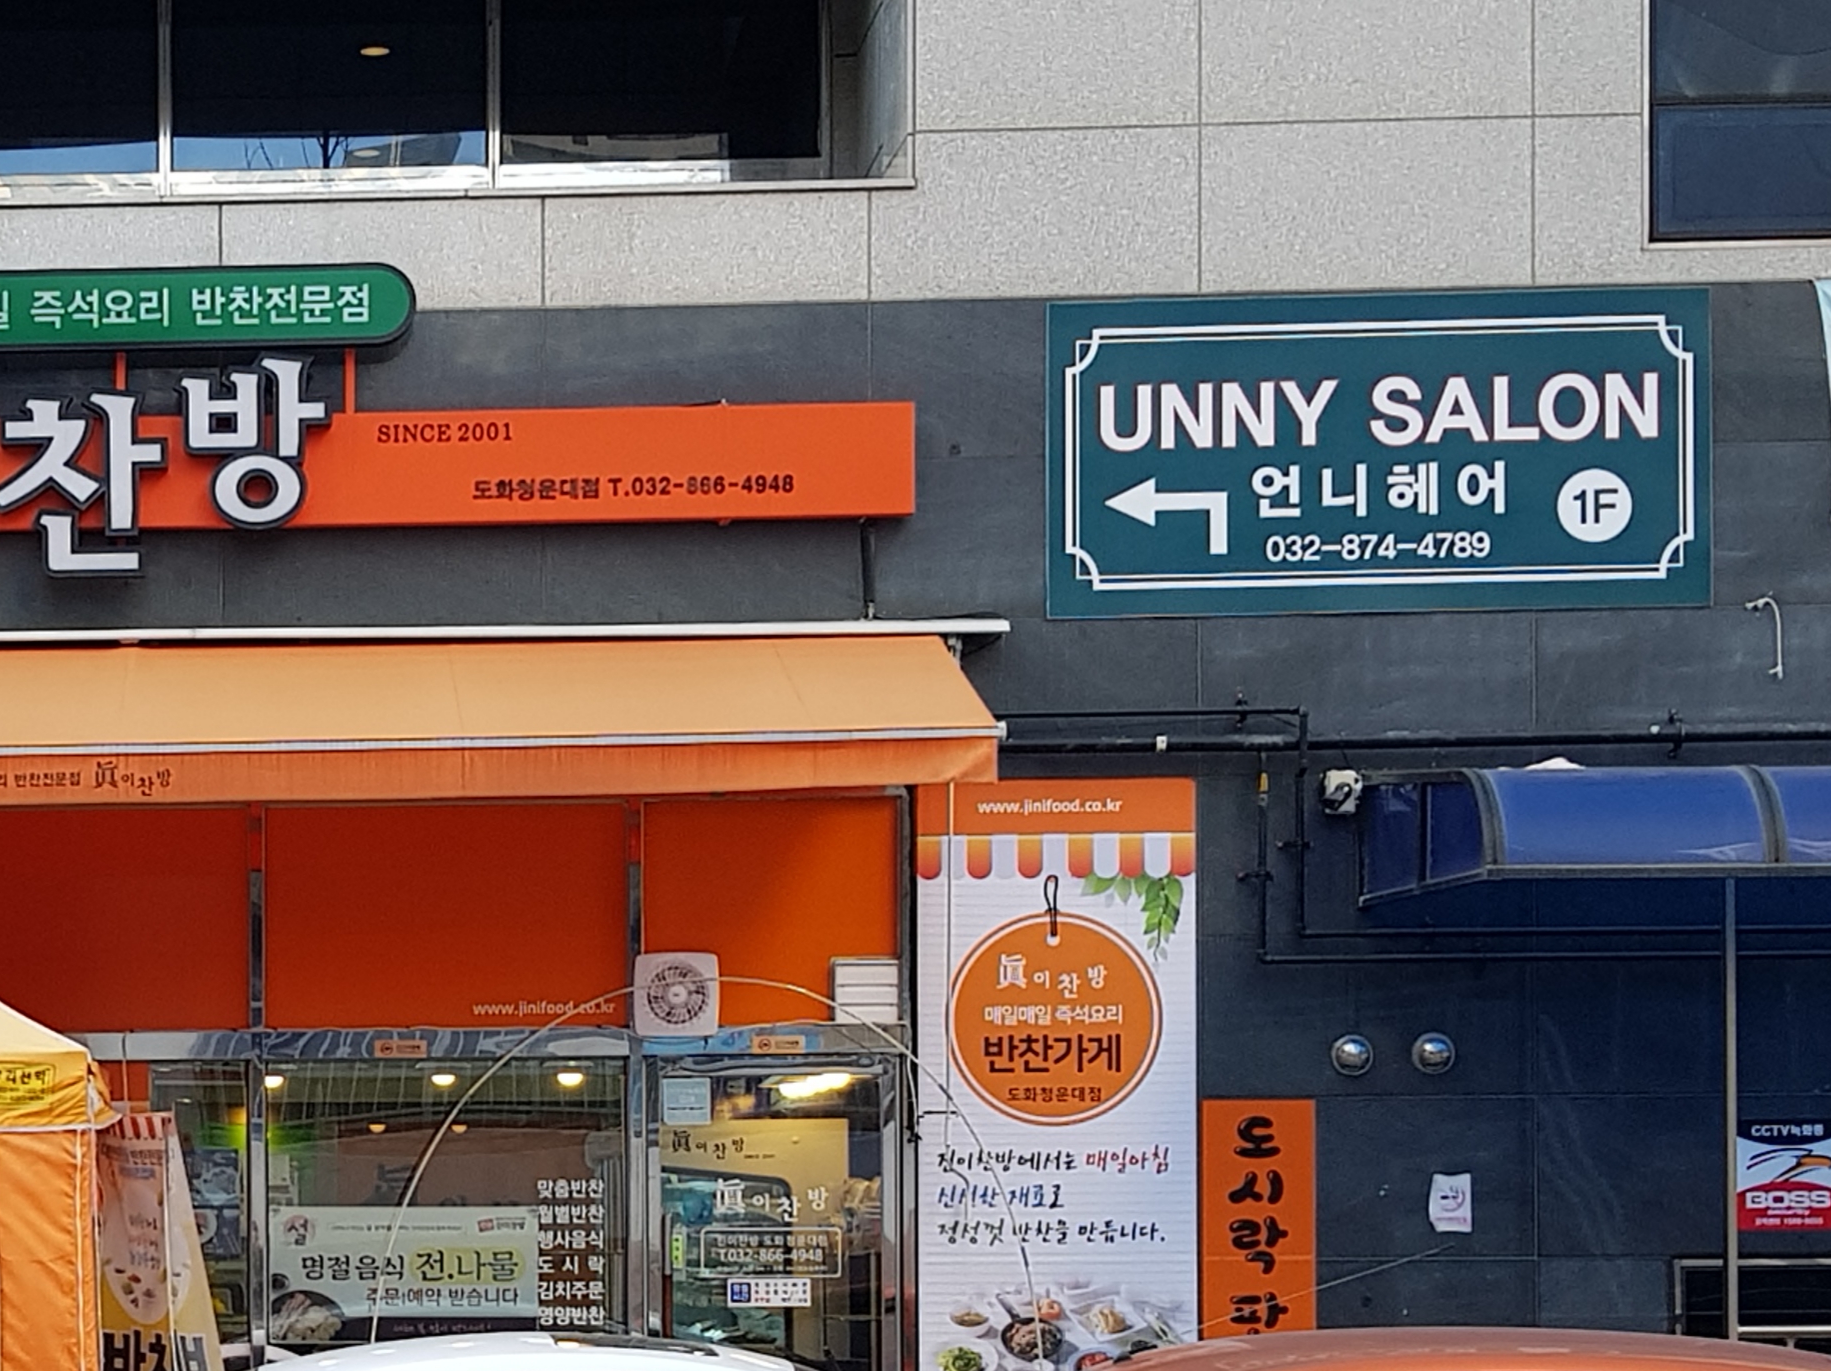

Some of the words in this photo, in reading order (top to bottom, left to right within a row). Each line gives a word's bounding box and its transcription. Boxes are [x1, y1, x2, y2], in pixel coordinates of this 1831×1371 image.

[30, 287, 170, 329] 즉석요리
[191, 283, 371, 326] 반찬전문점
[1098, 378, 1340, 451] UNNY
[1368, 371, 1659, 446] SALON
[376, 423, 452, 444] SINCE
[457, 421, 514, 443] 2001
[607, 473, 795, 498] T.032-866-4948
[1250, 459, 1506, 519] 언니헤어
[1571, 486, 1619, 525] 1F
[1265, 531, 1491, 564] 032-874-4789
[977, 798, 1123, 817] www.jinifood.co.kr
[984, 1005, 1052, 1026] 매일매일
[1055, 1004, 1122, 1025] 즉석요리
[984, 1033, 1122, 1074] 반찬가게
[1007, 1086, 1103, 1103] 도화청운대점
[1085, 1144, 1170, 1175] 매일아침
[537, 1178, 605, 1199] 맞춤반찬
[1008, 1184, 1066, 1209] 재료로
[1228, 1116, 1289, 1274] 도시락
[1745, 1191, 1830, 1208] BOSS
[286, 1217, 310, 1246] 설
[937, 1217, 1005, 1246] 정성껏
[301, 1253, 406, 1283] 명절음식
[448, 1286, 520, 1308] 받습니다
[537, 1281, 605, 1301] 김치주문
